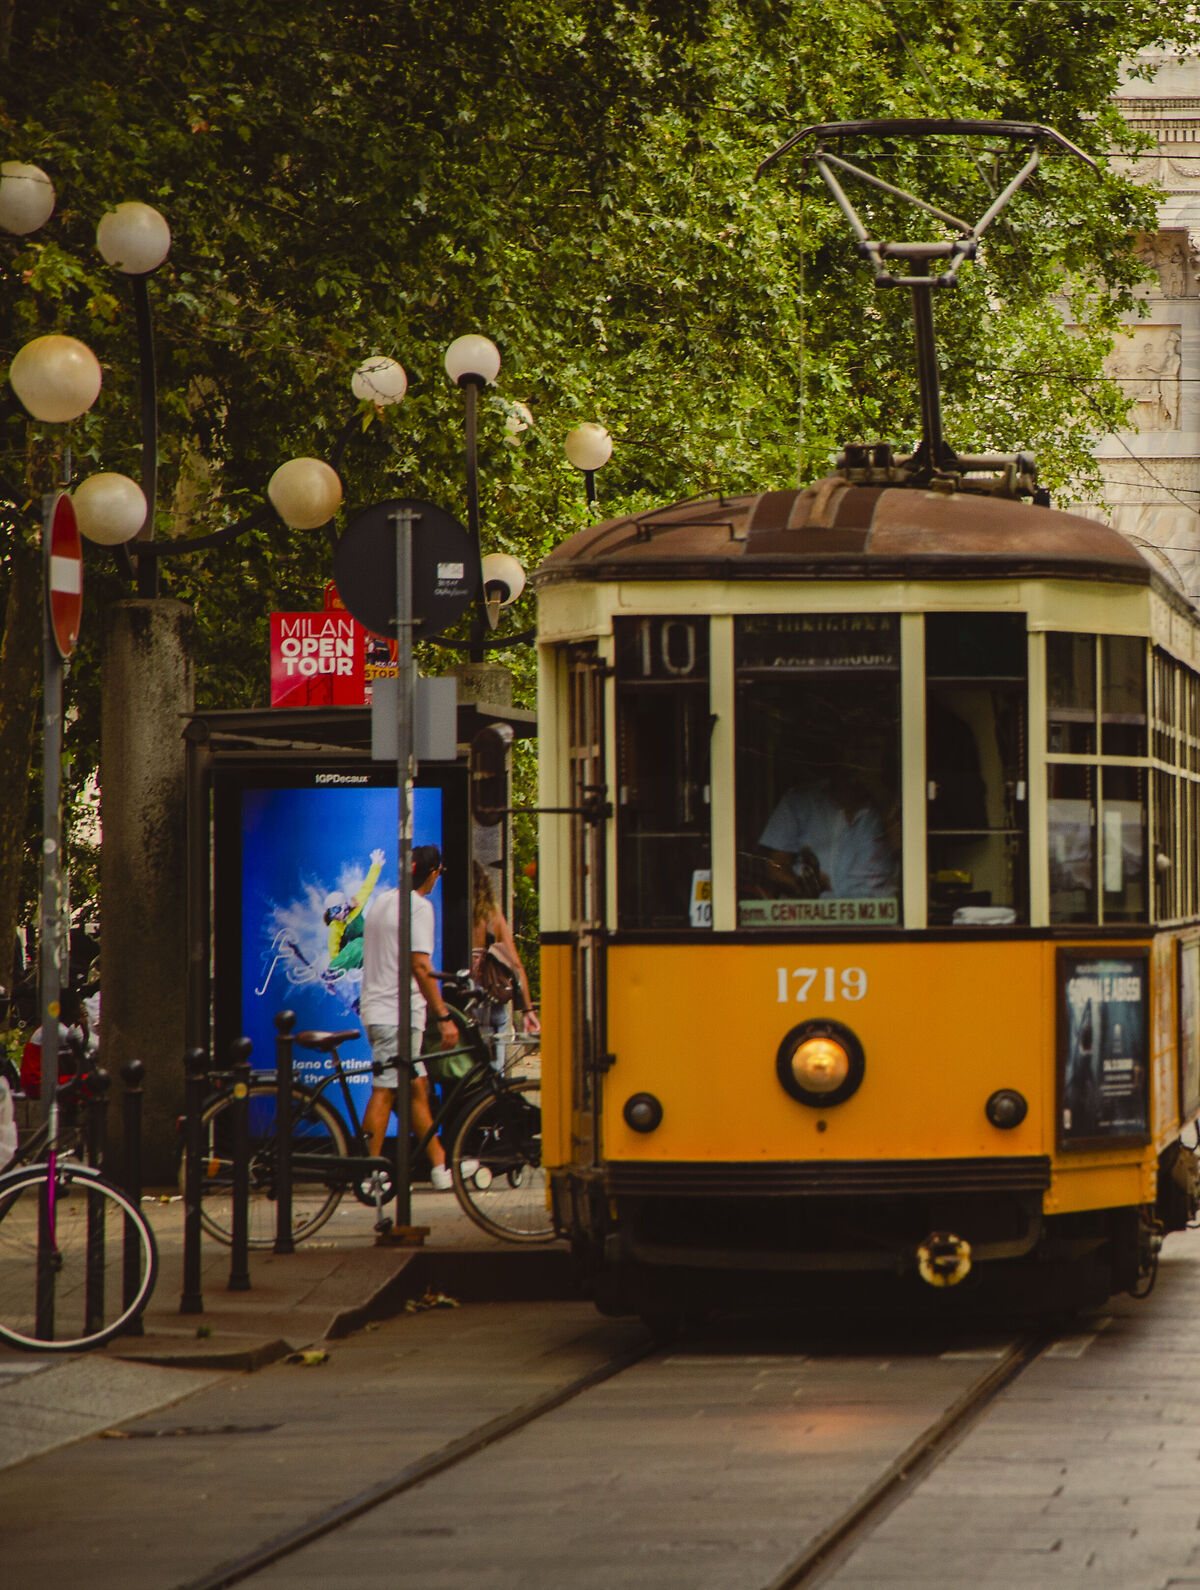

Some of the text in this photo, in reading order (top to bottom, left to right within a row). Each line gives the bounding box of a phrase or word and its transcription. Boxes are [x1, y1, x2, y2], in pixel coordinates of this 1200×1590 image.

[280, 618, 354, 638] MILAN
[280, 637, 354, 657] OPEN
[640, 620, 696, 677] 10
[281, 657, 354, 676] TOUR
[771, 903, 837, 920] CENTRALE
[859, 903, 875, 920] M2
[879, 902, 895, 919] M3
[777, 967, 868, 1003] 1719
